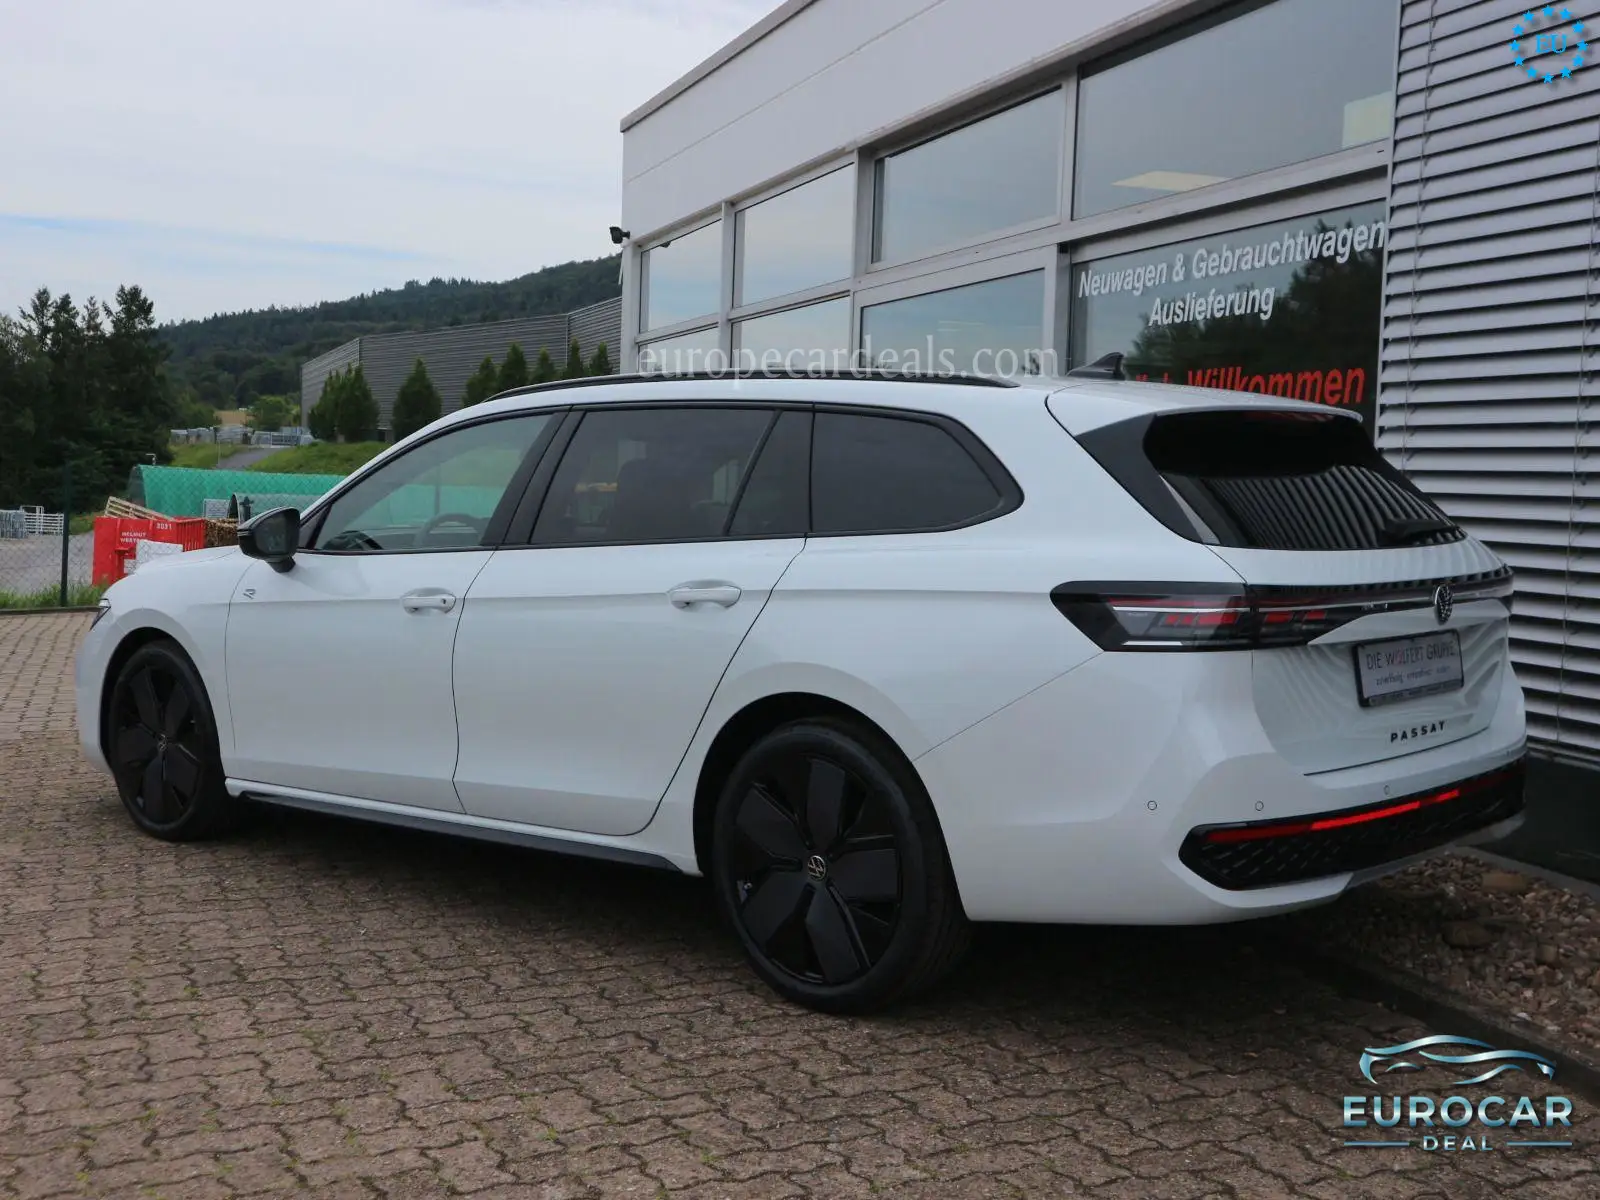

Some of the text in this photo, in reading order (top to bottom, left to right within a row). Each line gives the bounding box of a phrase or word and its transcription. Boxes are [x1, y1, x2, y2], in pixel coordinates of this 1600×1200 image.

[1078, 220, 1386, 298] Neuwagen & Gebrauchtwagen
[1148, 287, 1276, 327] Auslieferung
[1365, 652, 1383, 670] DIE
[1390, 720, 1446, 743] PASSAT
